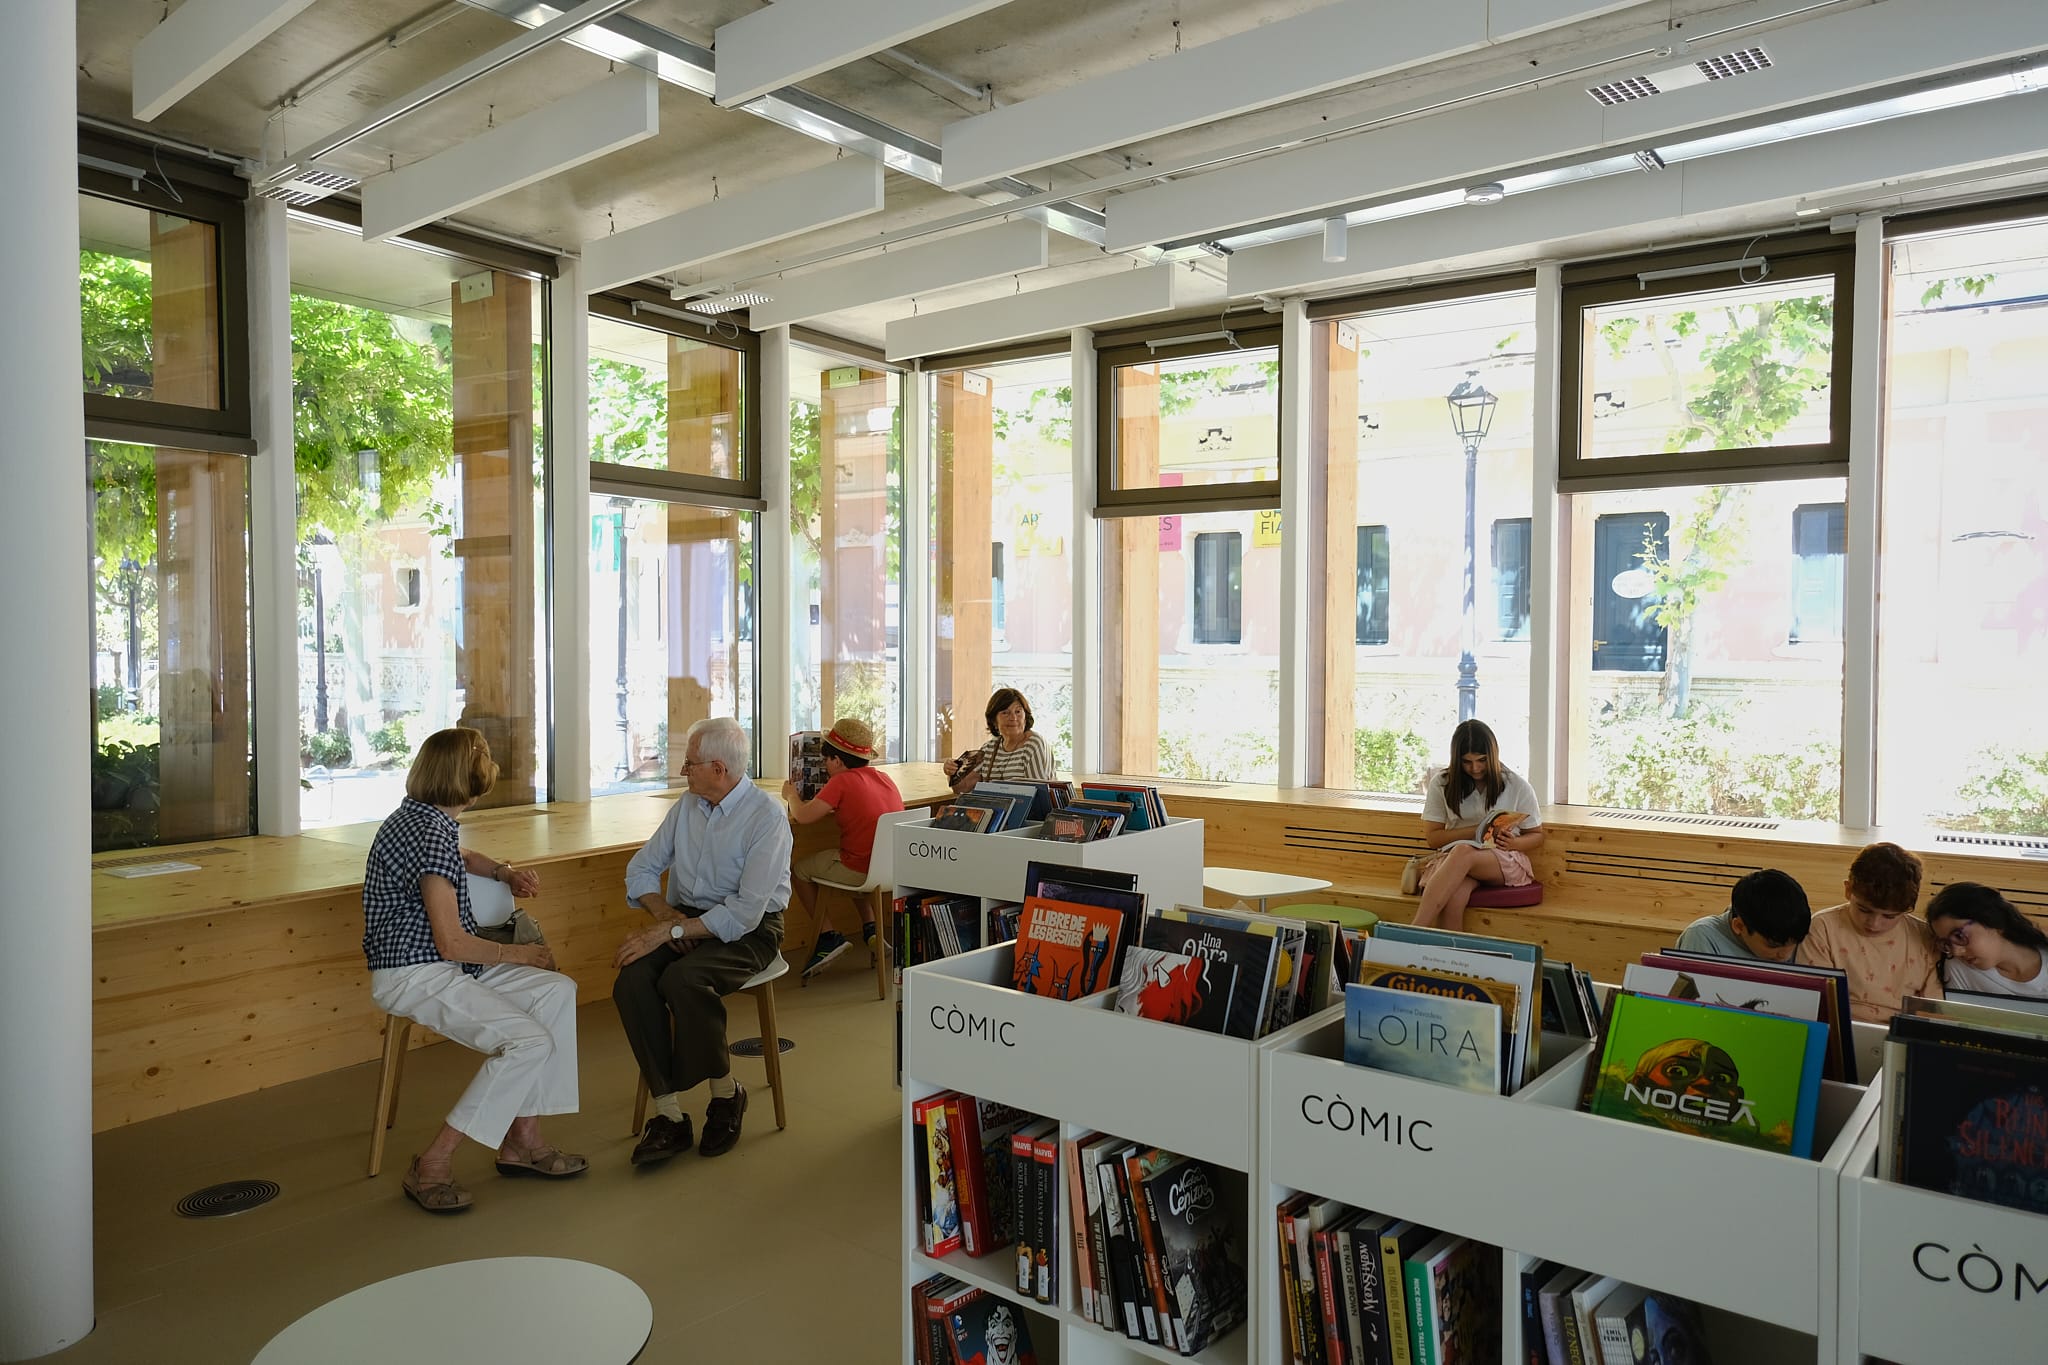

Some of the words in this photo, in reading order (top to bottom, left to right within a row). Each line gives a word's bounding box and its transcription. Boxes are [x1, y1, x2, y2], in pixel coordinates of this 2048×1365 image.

[908, 840, 958, 862] CÒMIC
[1032, 908, 1071, 929] LLIBRE
[1070, 914, 1088, 932] DE
[1028, 924, 1048, 941] LES
[1047, 927, 1084, 948] BESTIES
[1203, 932, 1222, 949] Una
[930, 1003, 1016, 1047] CÒMIC
[1356, 1009, 1481, 1063] LOIRA
[1301, 1093, 1433, 1152] CÒMIC
[1013, 1141, 1032, 1152] MARVEL
[1034, 1147, 1053, 1158] MARVEL
[1342, 1244, 1350, 1254] EL
[1344, 1254, 1352, 1274] NAO
[1346, 1274, 1354, 1285] DE
[927, 1303, 945, 1314] MARVEL
[1347, 1286, 1357, 1317] BROWN
[1413, 1278, 1421, 1296] NICK
[1418, 1331, 1426, 1357] TALLER
